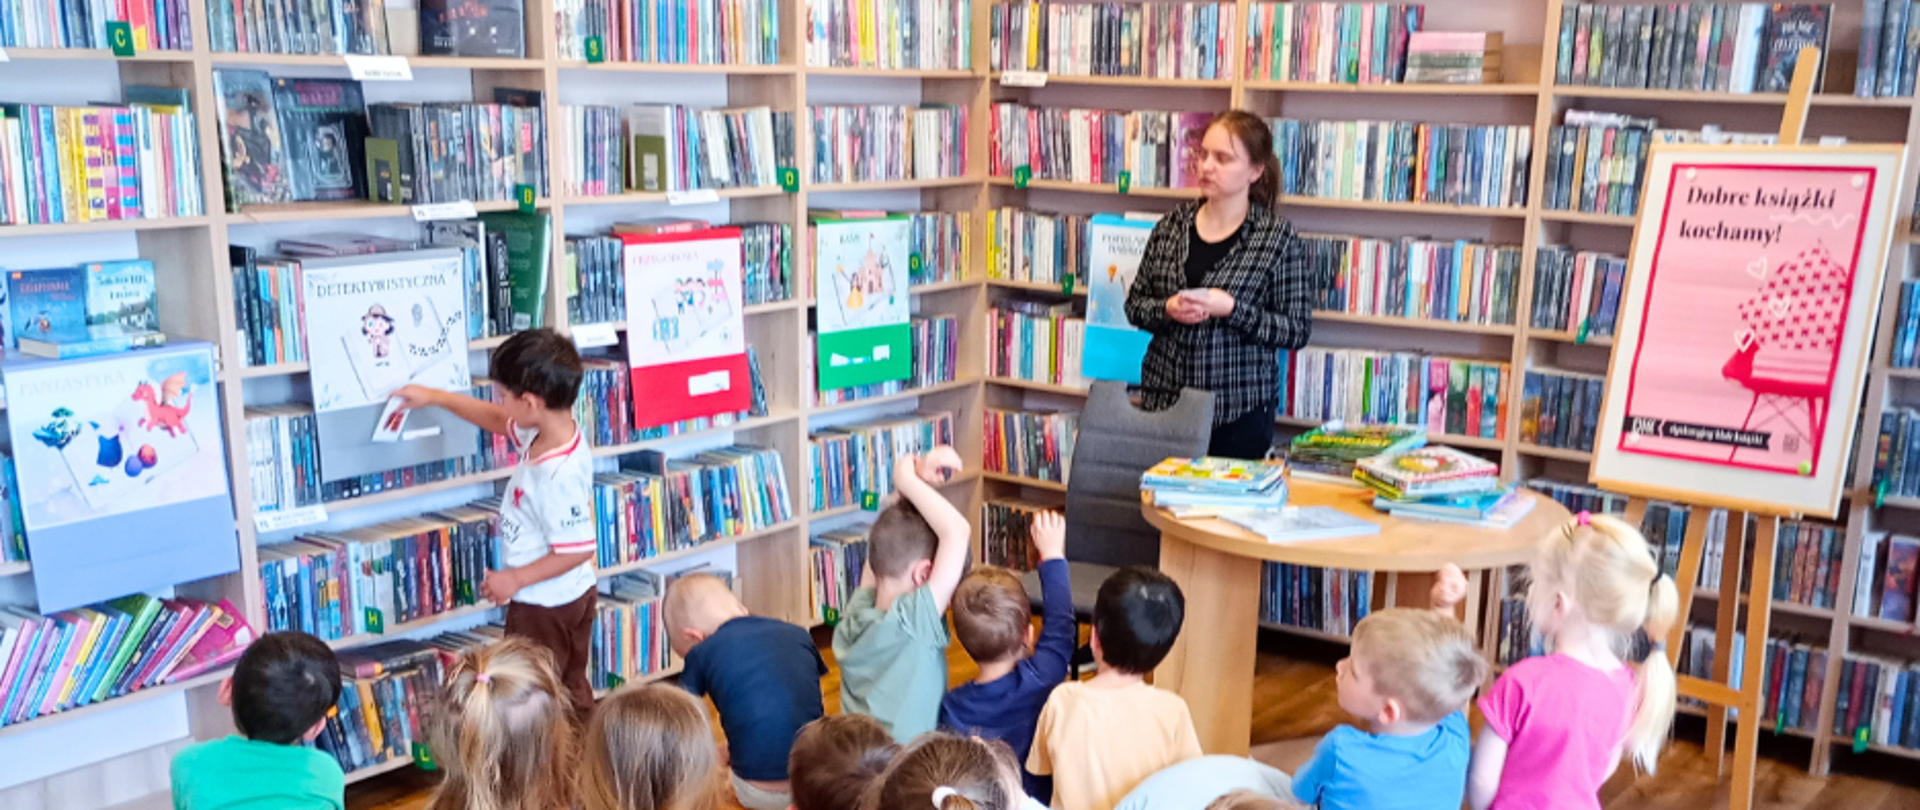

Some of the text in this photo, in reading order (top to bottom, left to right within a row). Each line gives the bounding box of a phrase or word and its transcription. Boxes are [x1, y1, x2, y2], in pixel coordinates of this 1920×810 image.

[115, 28, 126, 47] C
[1687, 186, 1836, 213] Dobre książki
[1679, 219, 1782, 248] kochamy!
[368, 611, 378, 626] H
[419, 747, 430, 761] L
